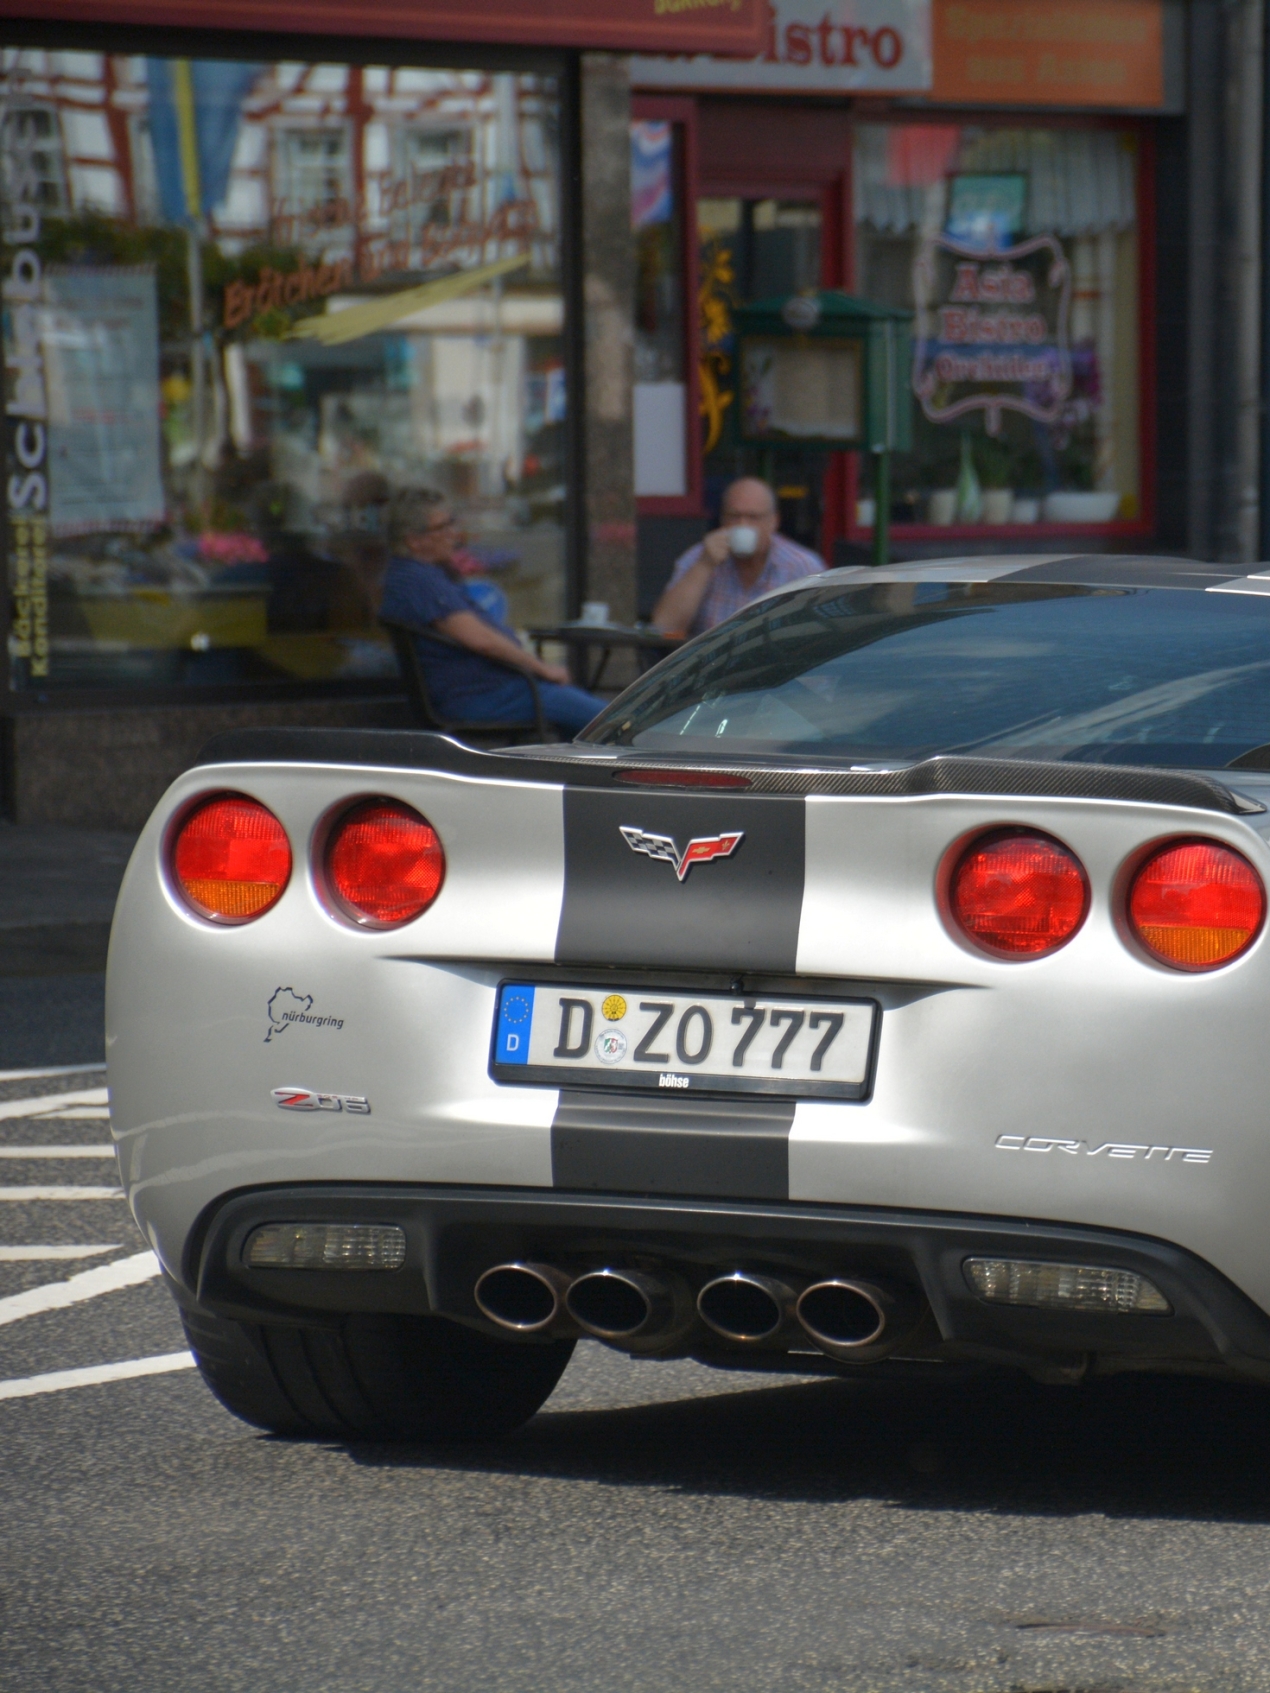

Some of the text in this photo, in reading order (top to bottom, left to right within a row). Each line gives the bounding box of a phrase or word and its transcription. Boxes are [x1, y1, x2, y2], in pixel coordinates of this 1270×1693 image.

[730, 3, 904, 69] istro
[949, 262, 1035, 303] Asia
[938, 304, 1048, 344] Bistro
[30, 517, 48, 677] Konditorei
[281, 1010, 344, 1030] nürburgring
[553, 997, 594, 1058] D
[730, 1006, 845, 1072] 777
[271, 1088, 370, 1114] Z06
[657, 1073, 690, 1089] böhse
[994, 1134, 1214, 1164] CORVETTE
